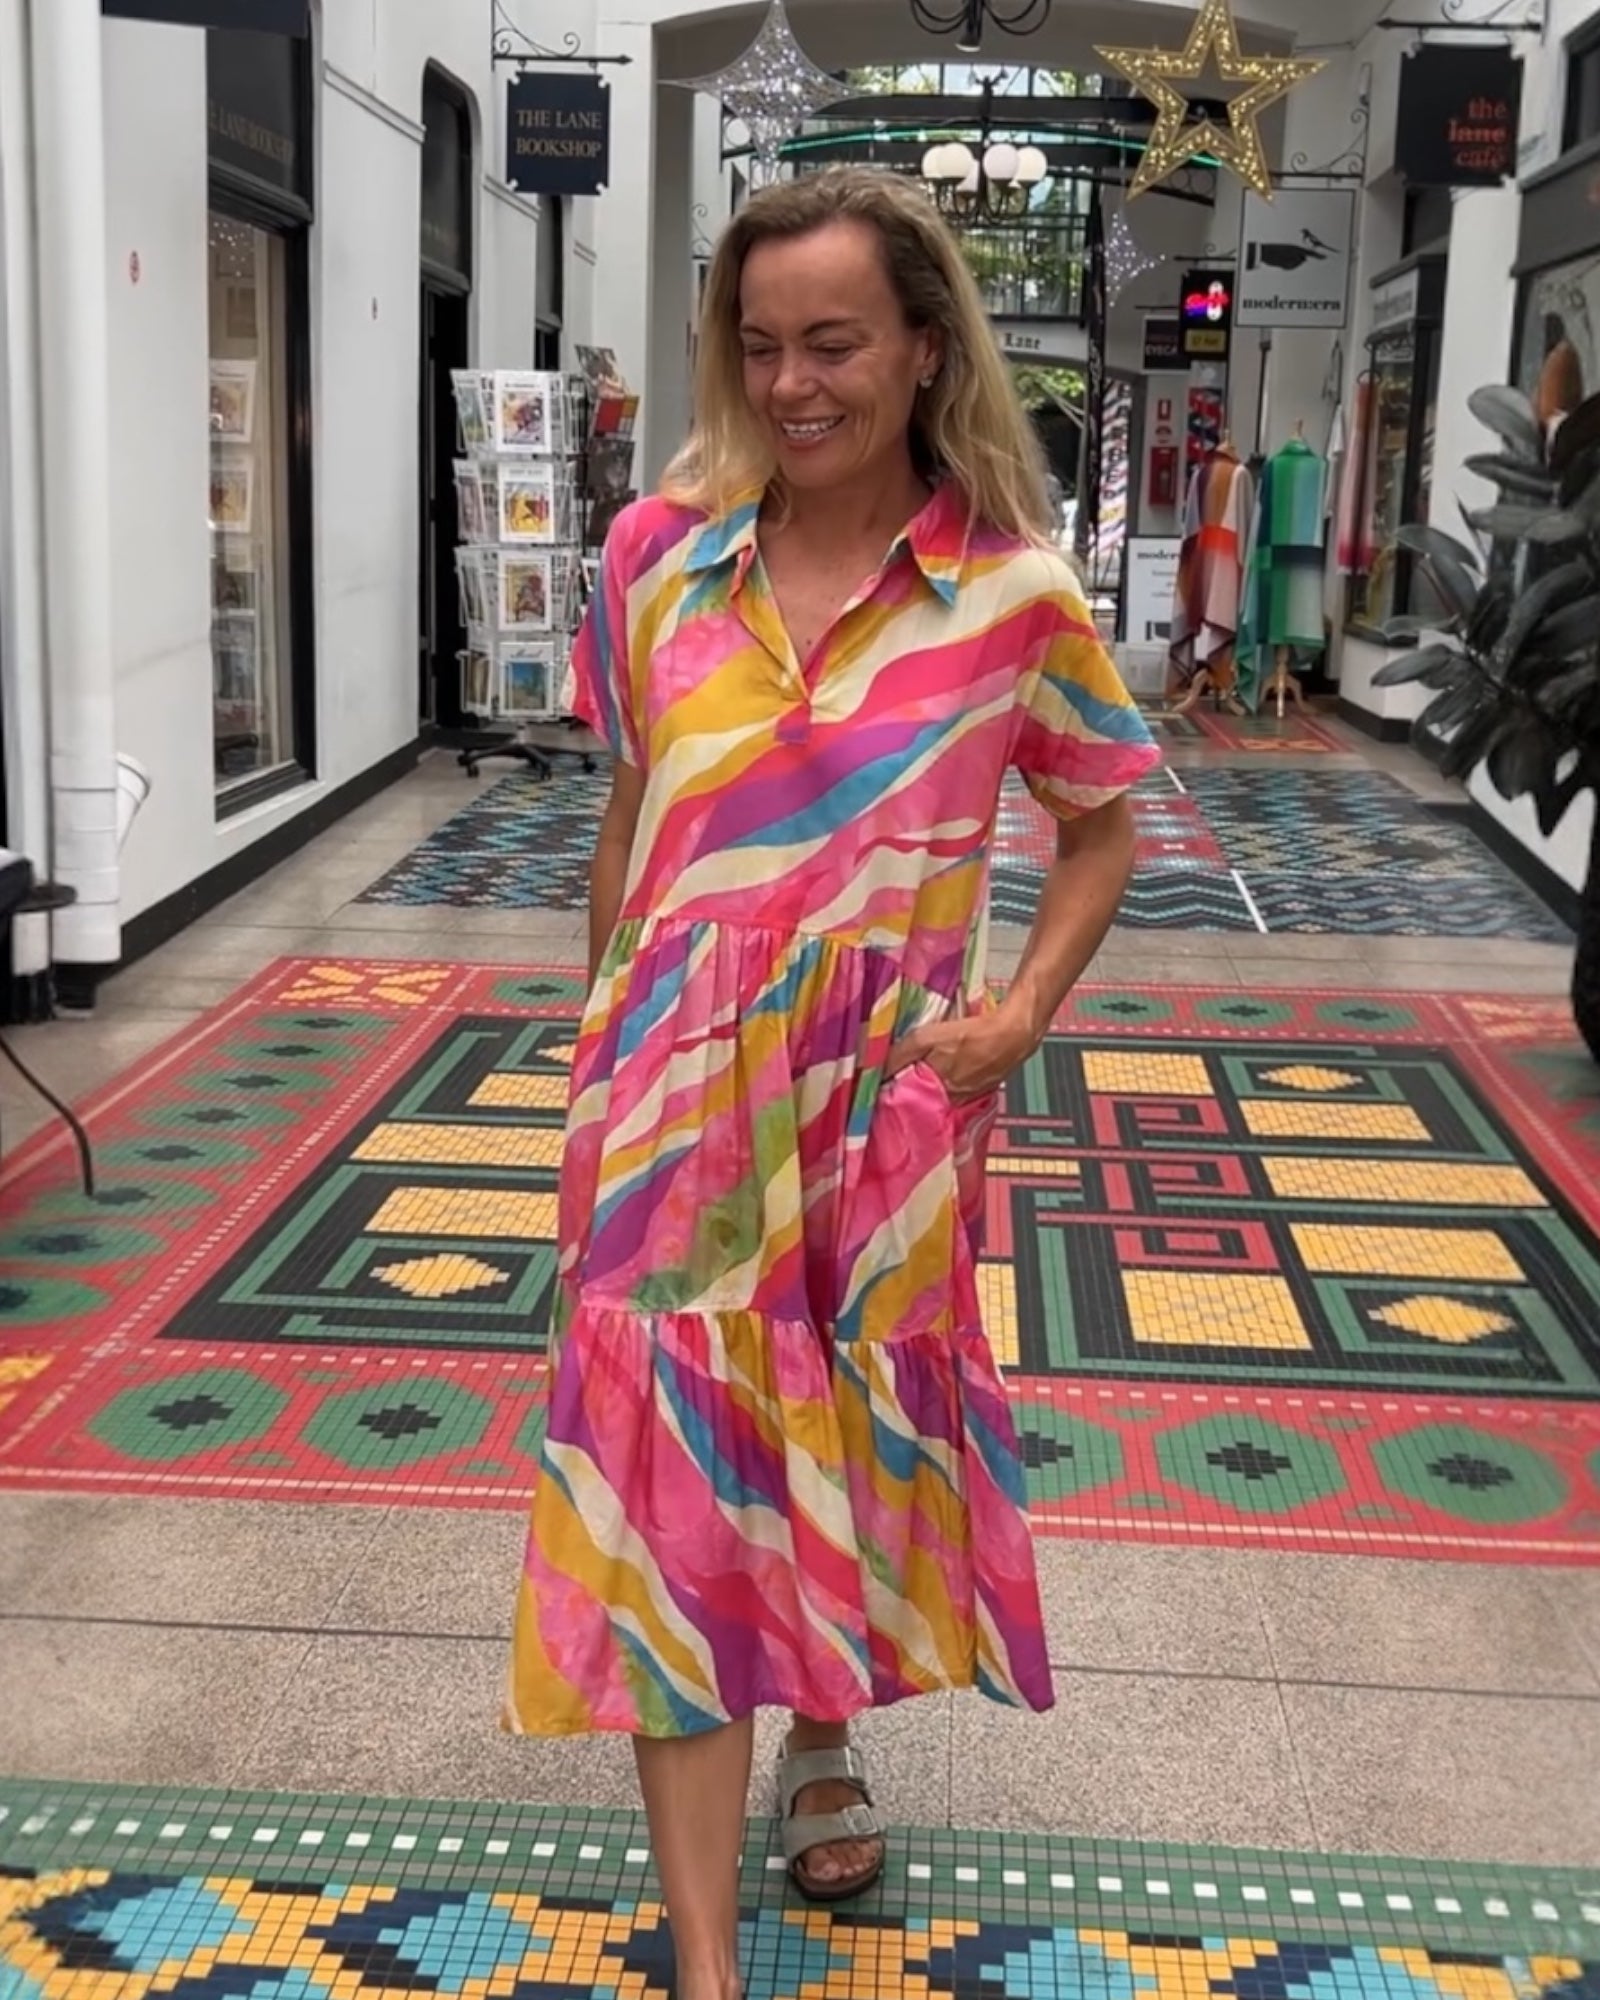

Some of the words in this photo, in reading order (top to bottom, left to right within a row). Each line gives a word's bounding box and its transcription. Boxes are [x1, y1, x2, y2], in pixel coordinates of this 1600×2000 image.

[1468, 96, 1507, 120] the
[515, 109, 550, 127] THE
[556, 110, 602, 129] LANE
[1448, 117, 1507, 143] lane
[515, 137, 603, 158] BOOKSHOP
[1004, 333, 1041, 350] Lane
